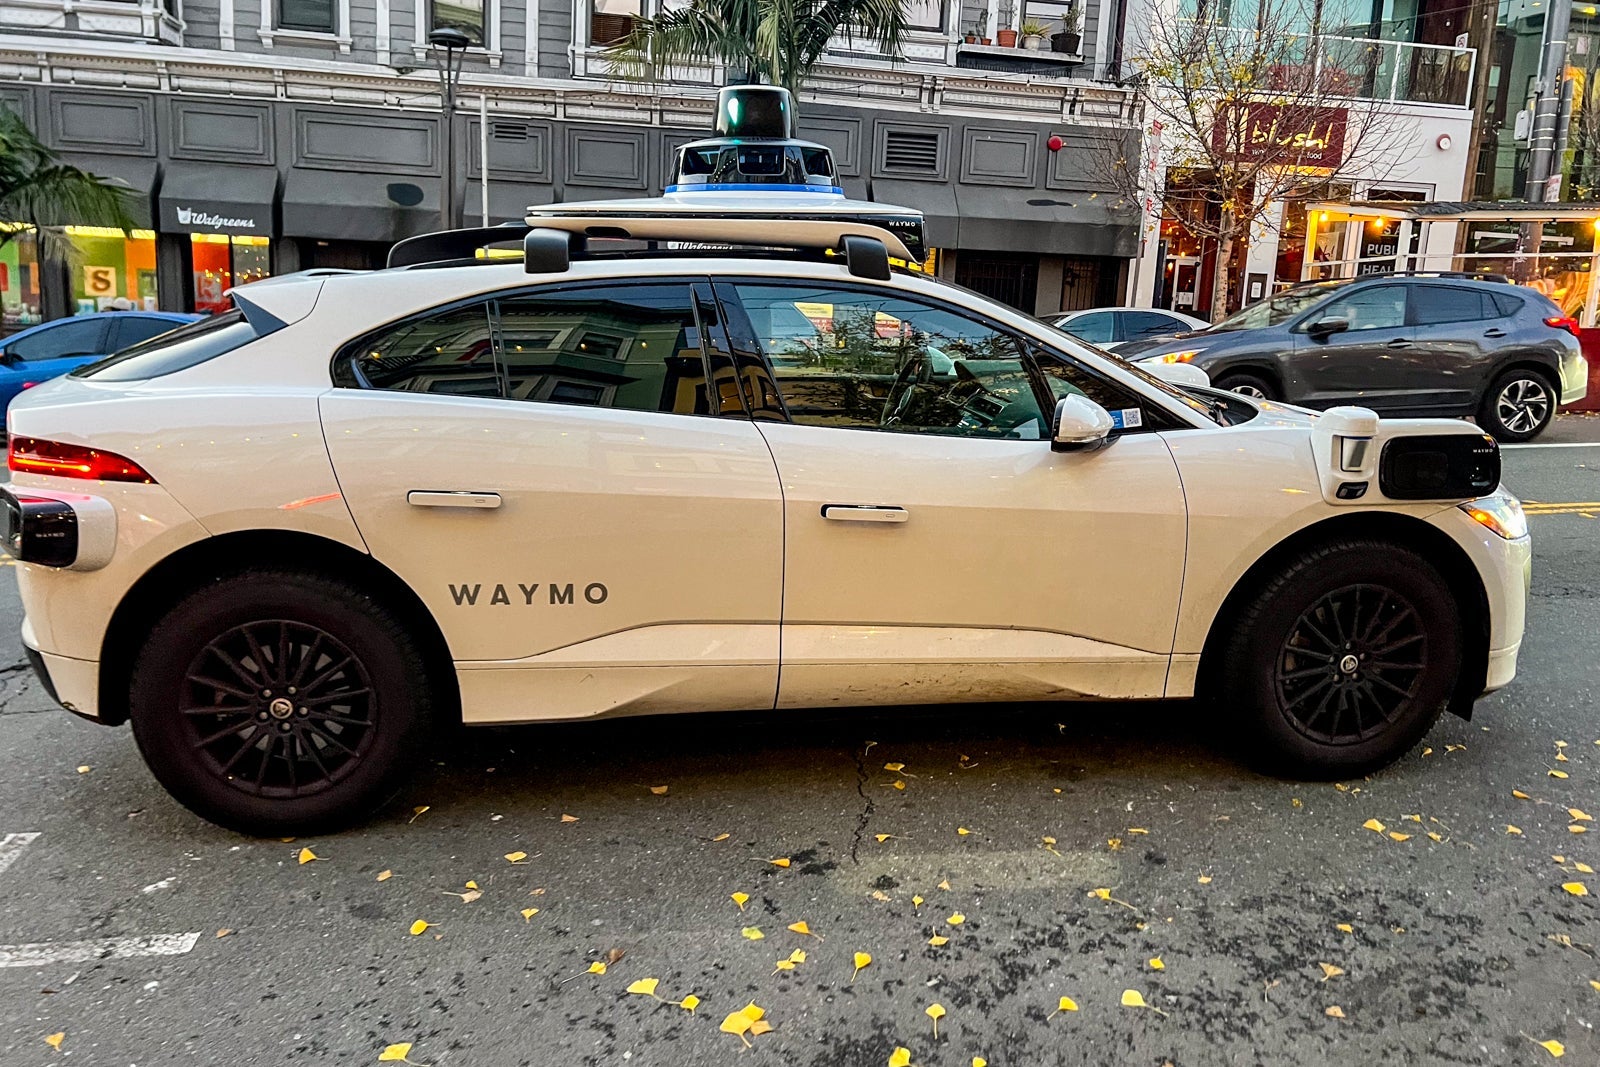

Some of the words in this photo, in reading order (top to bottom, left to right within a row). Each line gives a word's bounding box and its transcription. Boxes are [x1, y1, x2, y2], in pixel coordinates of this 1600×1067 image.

[191, 212, 255, 229] Walgreens
[1367, 244, 1397, 255] PUBL
[92, 270, 111, 292] S
[448, 582, 608, 606] WAYMO
